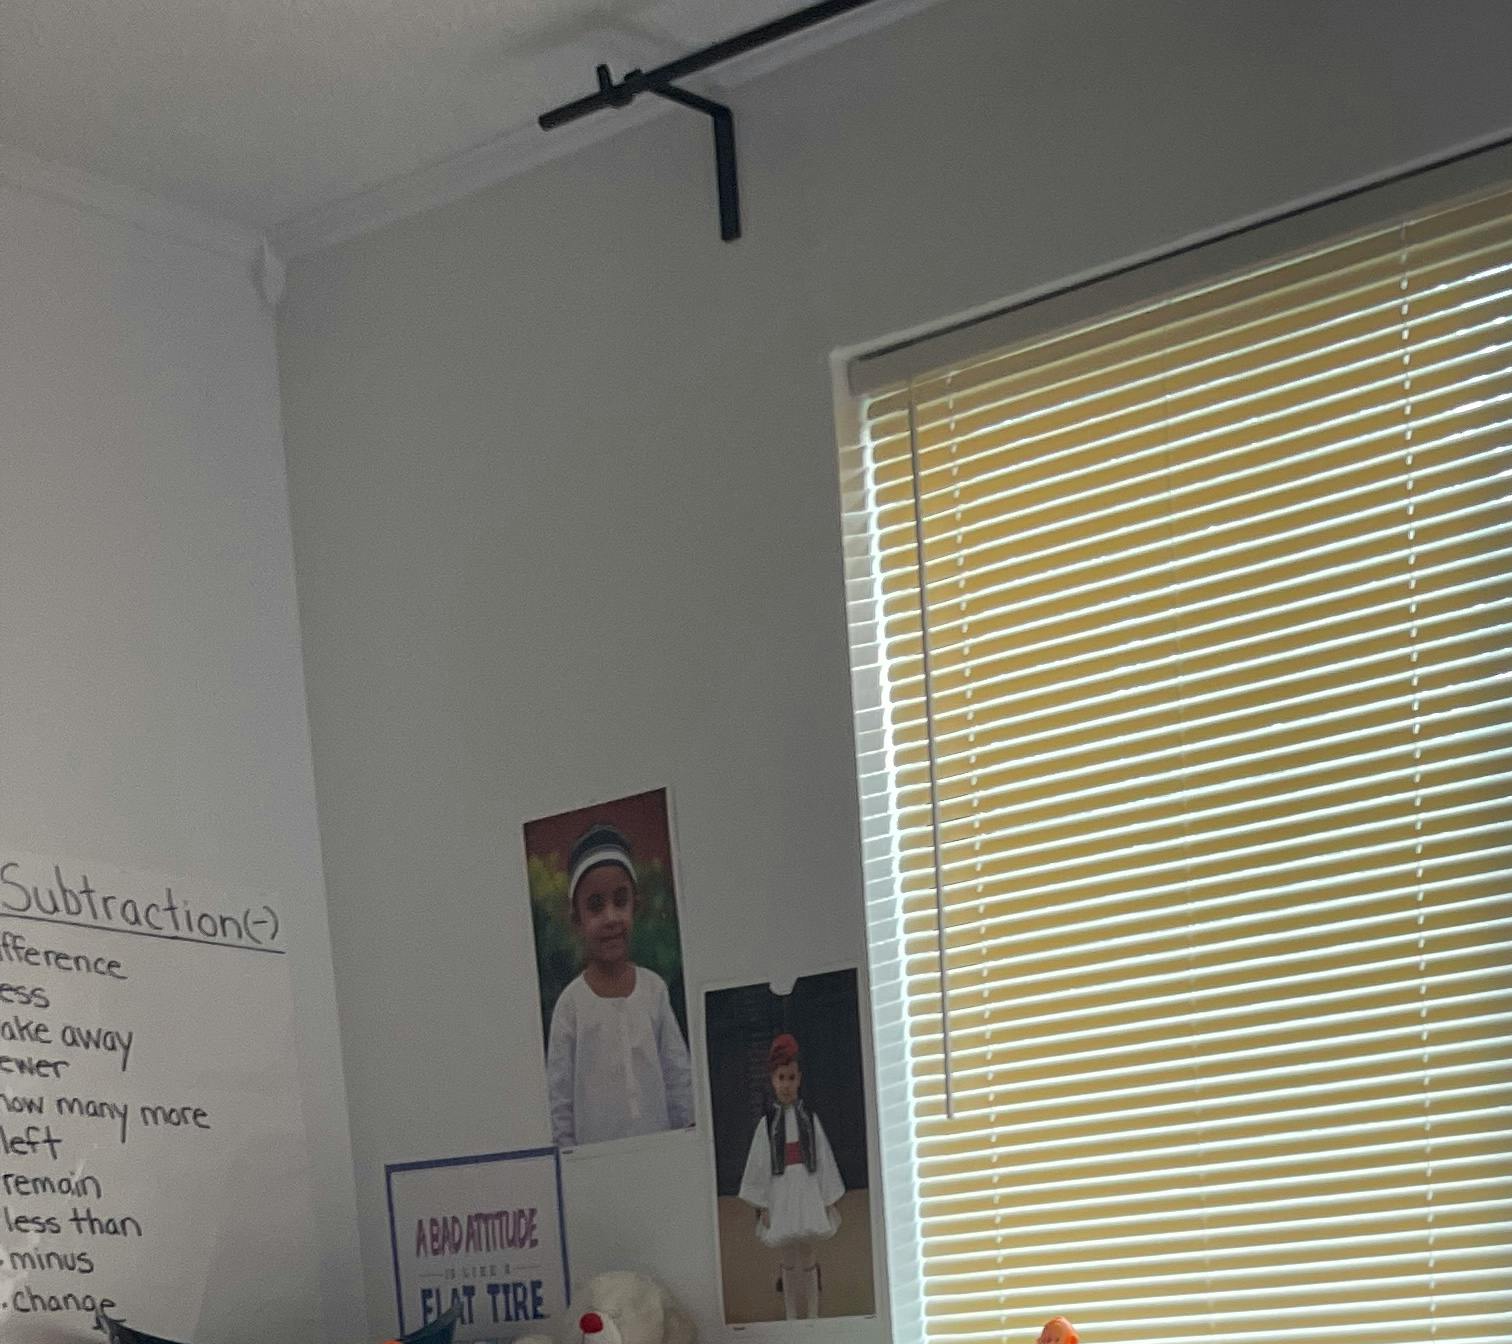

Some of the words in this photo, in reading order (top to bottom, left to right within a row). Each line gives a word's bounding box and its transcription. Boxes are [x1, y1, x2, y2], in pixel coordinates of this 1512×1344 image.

[61, 1025, 133, 1072] away
[0, 1125, 62, 1160] left
[56, 1097, 128, 1144] many
[140, 1105, 210, 1129] more
[3, 1171, 102, 1199] remain
[4, 1206, 61, 1234] less
[68, 1207, 143, 1237] than
[415, 1219, 428, 1259] A
[430, 1214, 464, 1257] BAD
[465, 1207, 539, 1252] ATTITUDE
[10, 1248, 94, 1274] minus
[13, 1286, 126, 1331] change
[487, 1280, 546, 1324] TIRE
